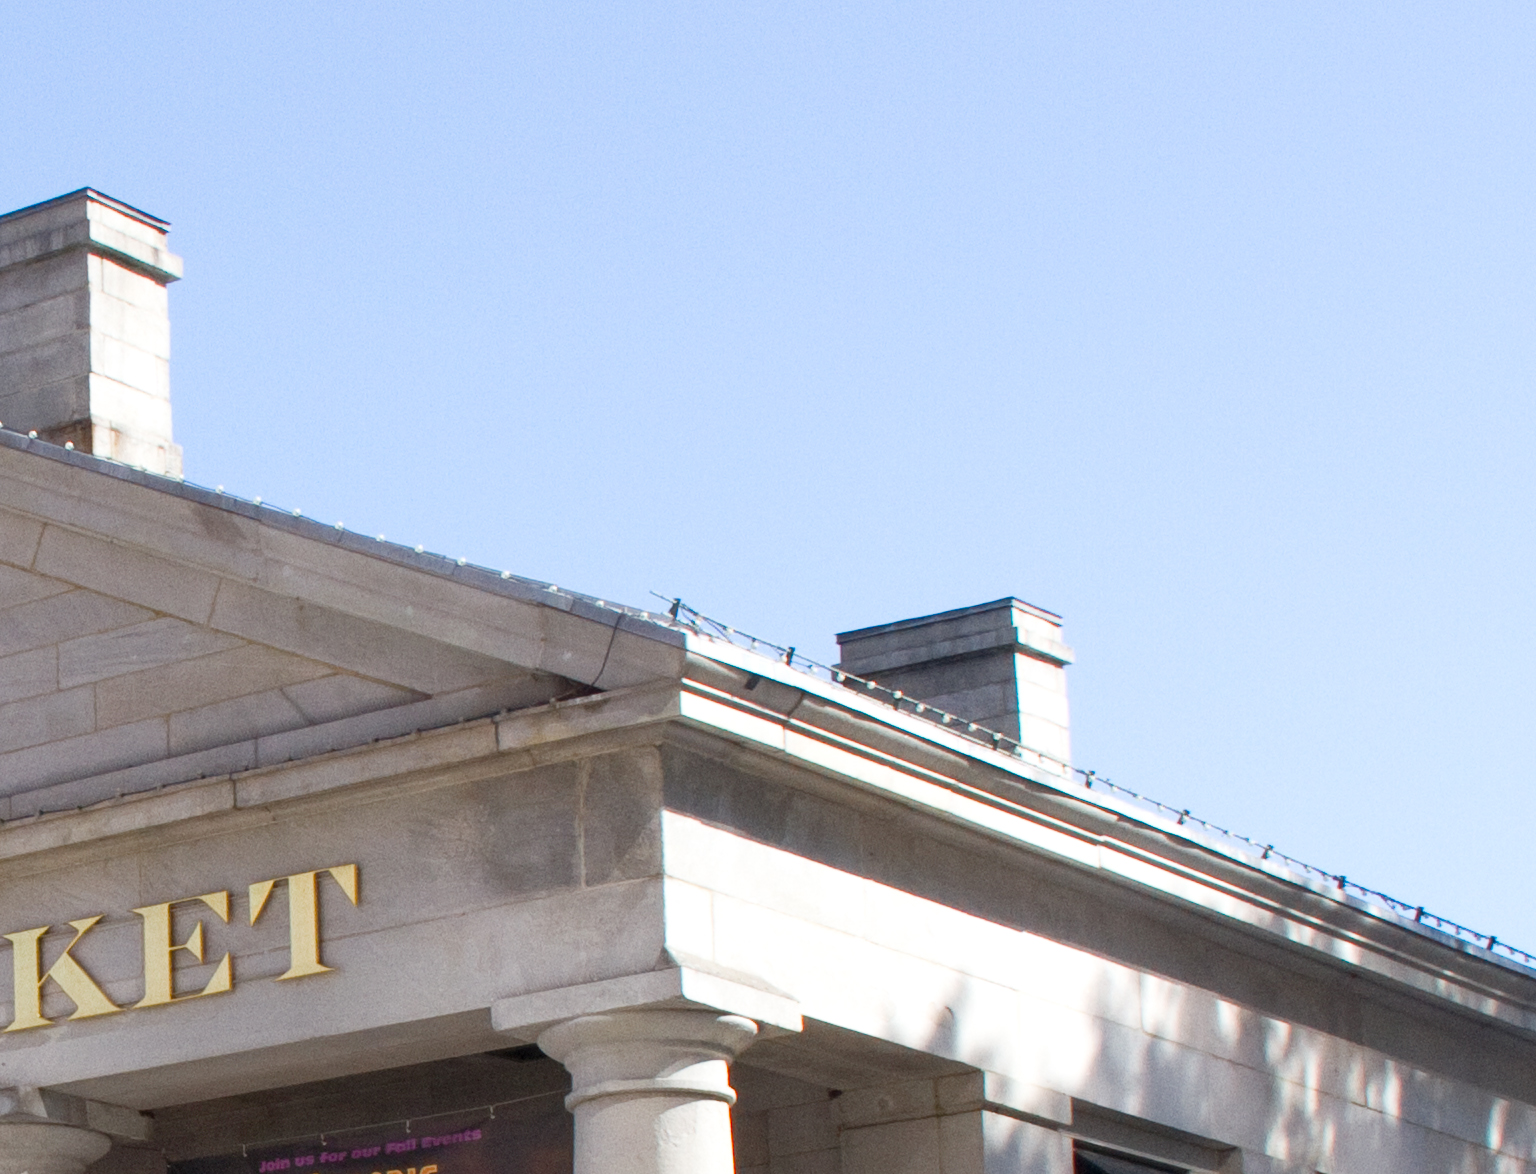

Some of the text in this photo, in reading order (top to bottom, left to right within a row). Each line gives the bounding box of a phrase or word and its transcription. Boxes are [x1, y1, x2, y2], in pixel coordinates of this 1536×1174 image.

[259, 1129, 482, 1173] Join us for our Fall Events
